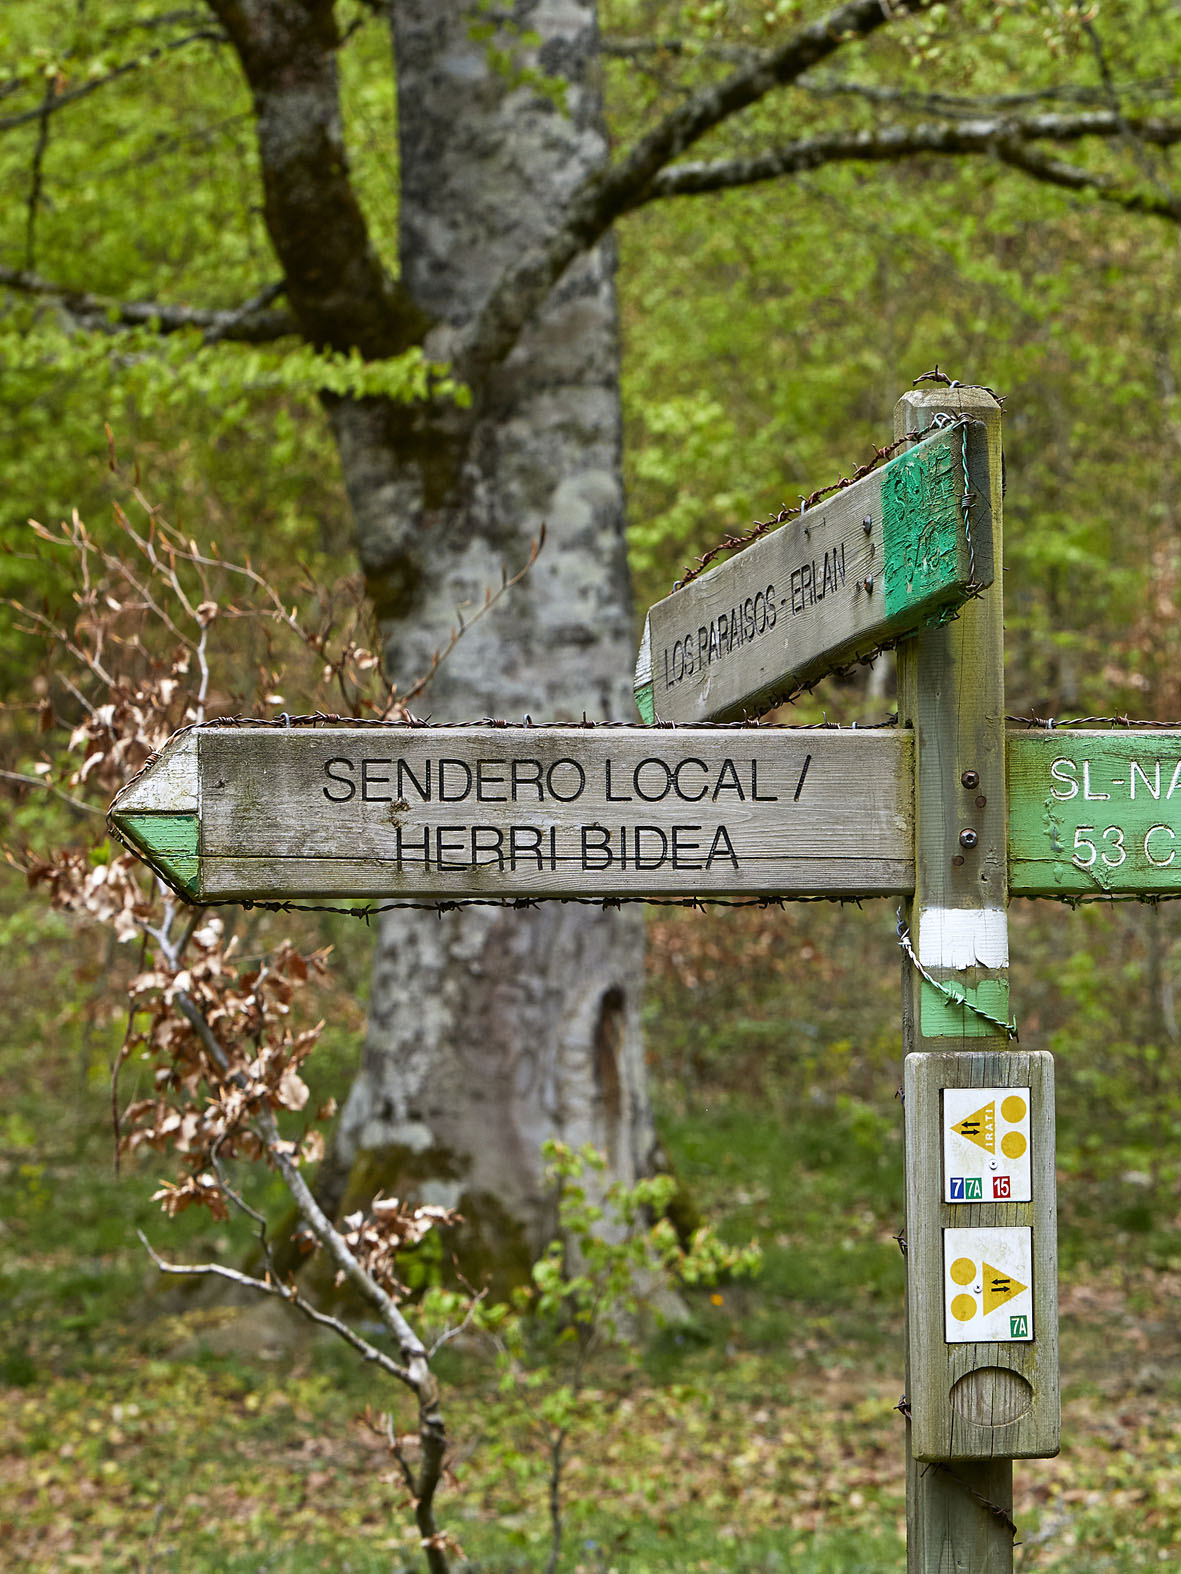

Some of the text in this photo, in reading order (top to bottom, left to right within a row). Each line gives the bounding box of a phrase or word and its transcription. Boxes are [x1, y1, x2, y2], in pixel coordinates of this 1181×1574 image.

[664, 633, 695, 691] LOS
[698, 584, 777, 671] PARAISOS
[790, 542, 846, 617] ERLAN
[322, 754, 813, 803] SENDERO LOCAL /
[395, 825, 740, 872] HERRI BIDEA
[1071, 823, 1177, 867] 53 C
[985, 1109, 994, 1146] IRATI
[952, 1178, 1010, 1197] 7 7A 15
[1012, 1317, 1027, 1335] 7A
